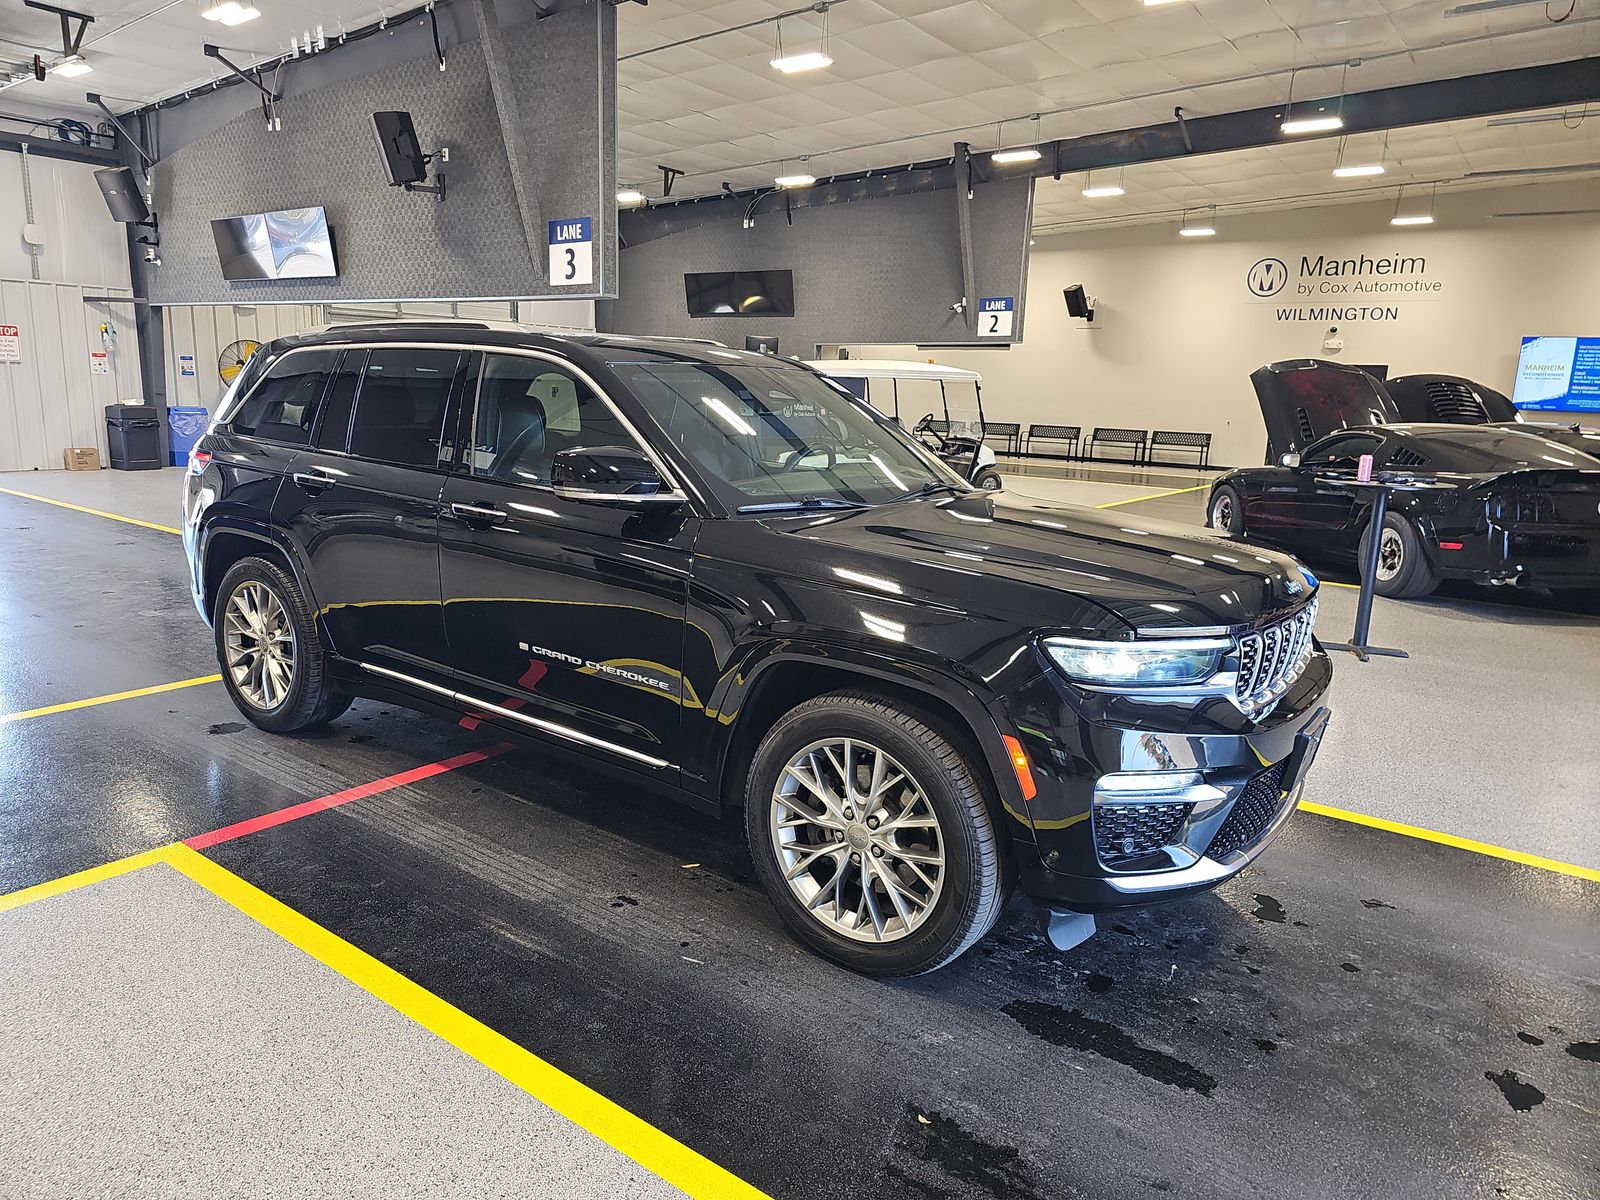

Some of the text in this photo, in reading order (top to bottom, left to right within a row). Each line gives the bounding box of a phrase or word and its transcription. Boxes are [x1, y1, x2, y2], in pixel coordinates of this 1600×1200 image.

[556, 223, 583, 241] LANE
[564, 247, 577, 280] 3
[1299, 253, 1426, 278] Manheim
[1297, 279, 1443, 297] by Cox Automotive
[985, 300, 1007, 311] LANE
[1276, 307, 1399, 321] WILMINGTON
[0, 327, 17, 336] TOP
[988, 314, 999, 333] 2
[531, 645, 670, 691] GRAND CHEROKEE
